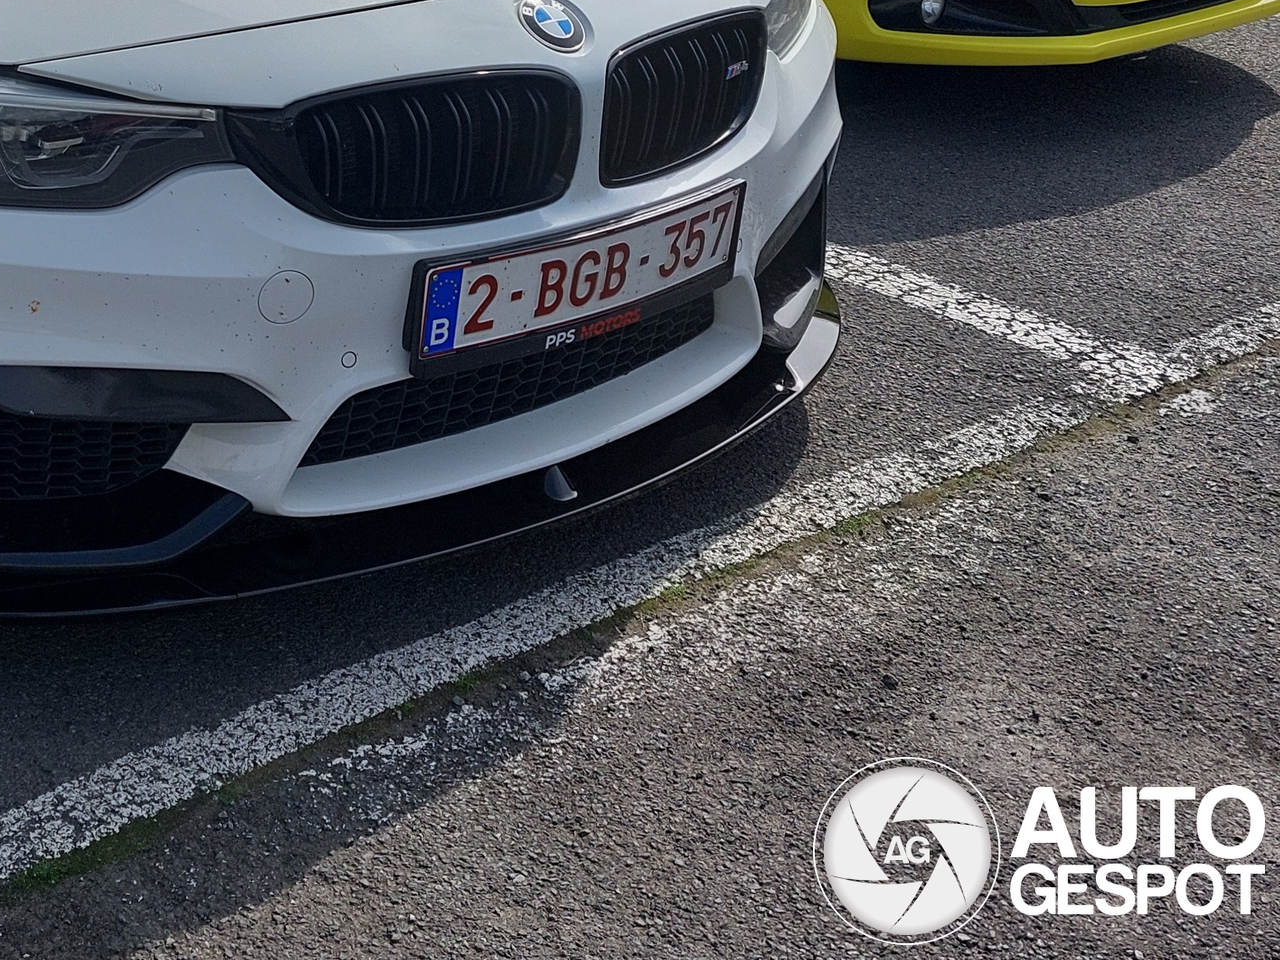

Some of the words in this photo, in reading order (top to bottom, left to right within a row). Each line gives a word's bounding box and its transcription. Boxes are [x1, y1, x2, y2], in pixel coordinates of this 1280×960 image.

[430, 317, 449, 346] B
[545, 329, 576, 349] PPS
[580, 308, 641, 339] MOTORS
